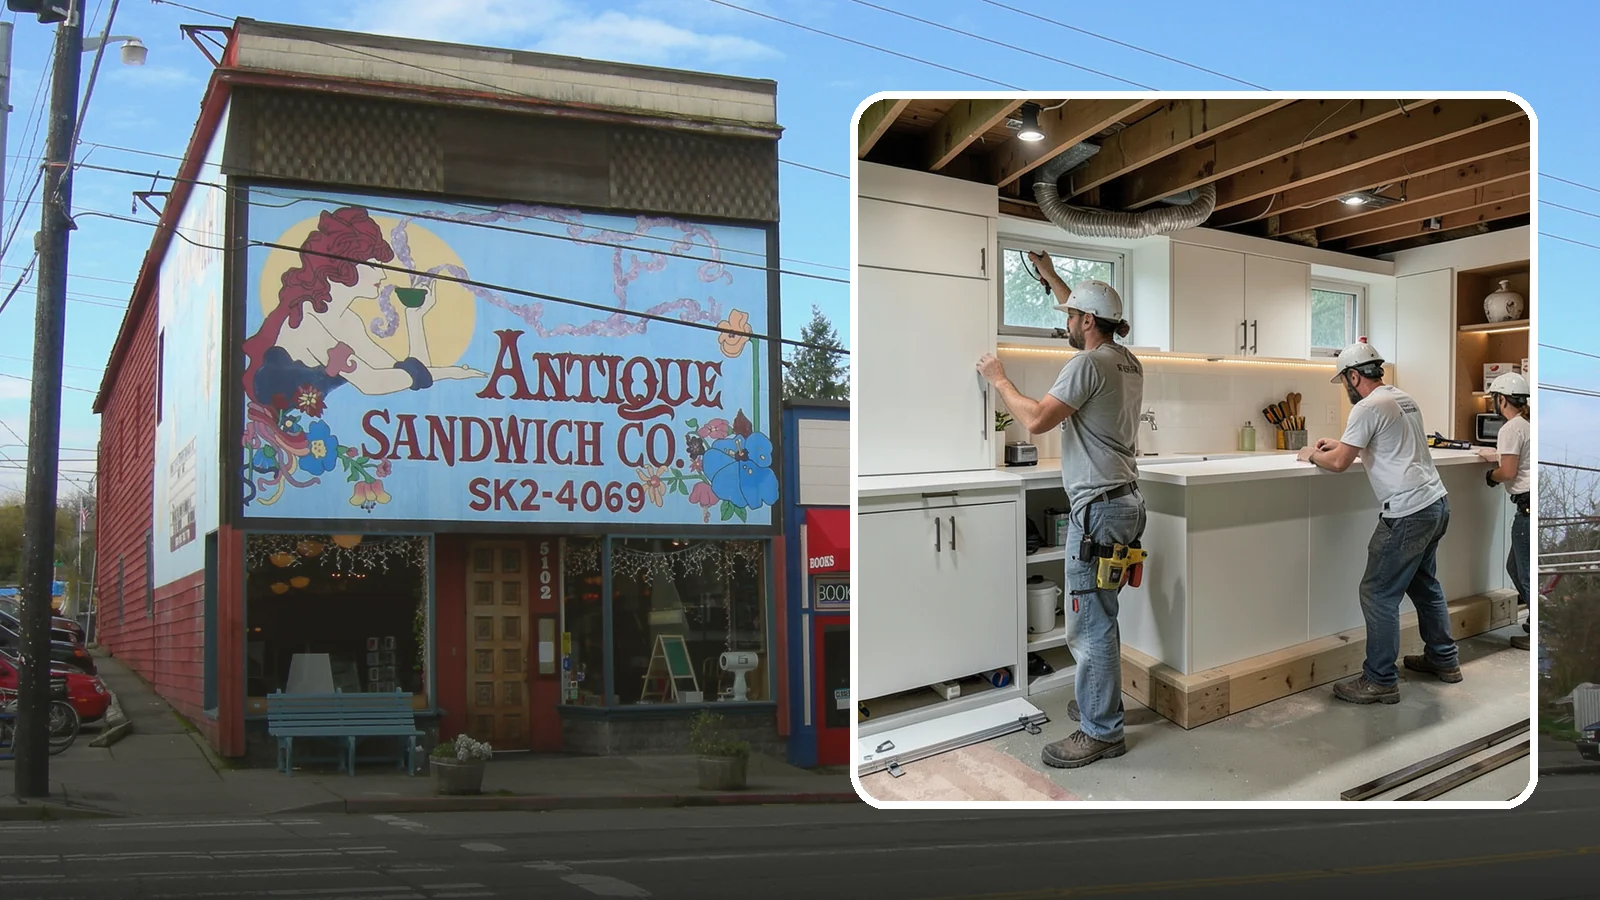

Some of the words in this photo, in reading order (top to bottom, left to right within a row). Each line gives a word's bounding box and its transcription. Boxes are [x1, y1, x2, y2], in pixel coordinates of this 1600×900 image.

[475, 329, 723, 421] ANTIQUE
[361, 408, 604, 467] SANDWICH
[617, 422, 685, 468] CO.
[469, 477, 645, 513] SK2-4069
[540, 541, 551, 600] 5102
[810, 555, 834, 569] BOOKS
